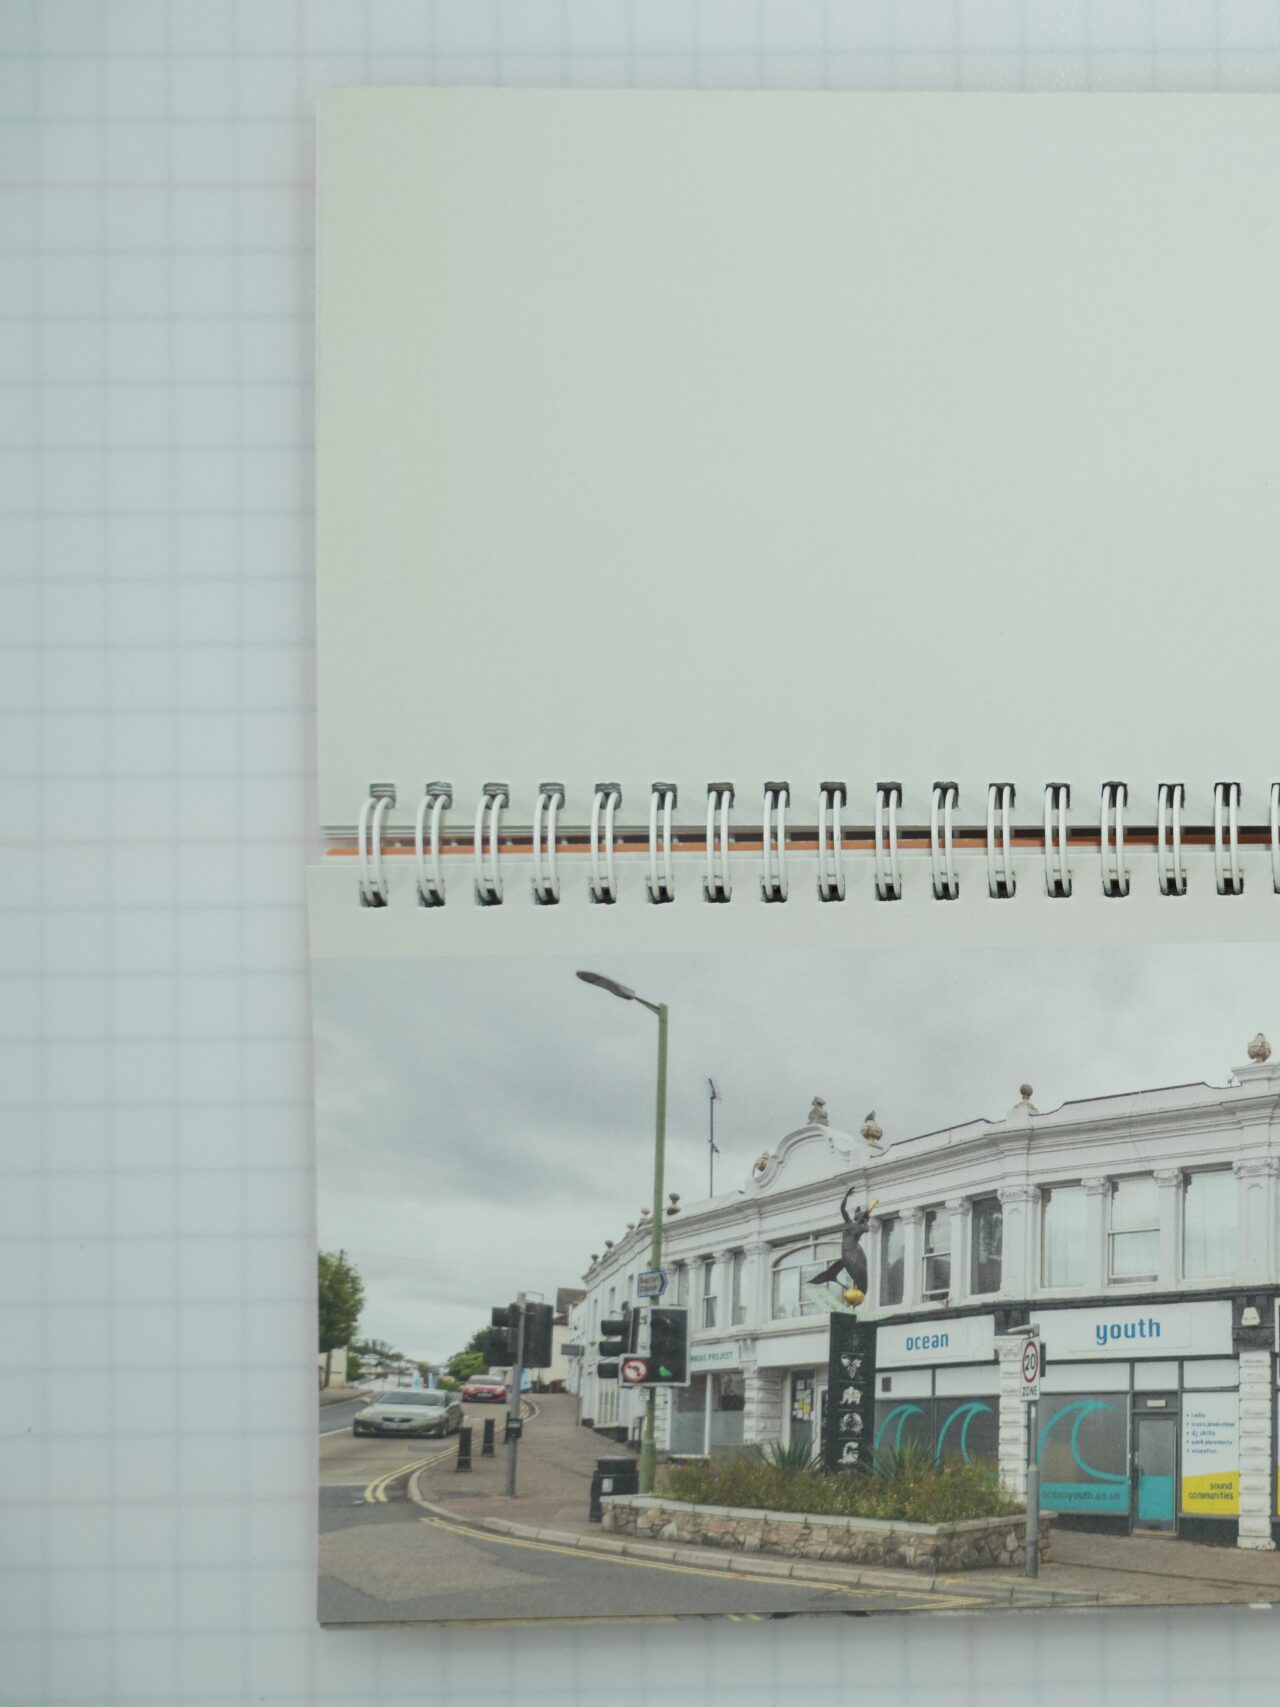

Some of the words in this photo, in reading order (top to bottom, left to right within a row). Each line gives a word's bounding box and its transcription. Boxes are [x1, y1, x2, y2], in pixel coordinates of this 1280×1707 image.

[1096, 1318, 1161, 1346] youth
[906, 1333, 949, 1351] ocean
[708, 1351, 733, 1361] PROJECT
[1025, 1353, 1036, 1372] 20
[1022, 1385, 1038, 1397] ZONE
[1210, 1482, 1233, 1490] sound
[1188, 1491, 1234, 1500] communities
